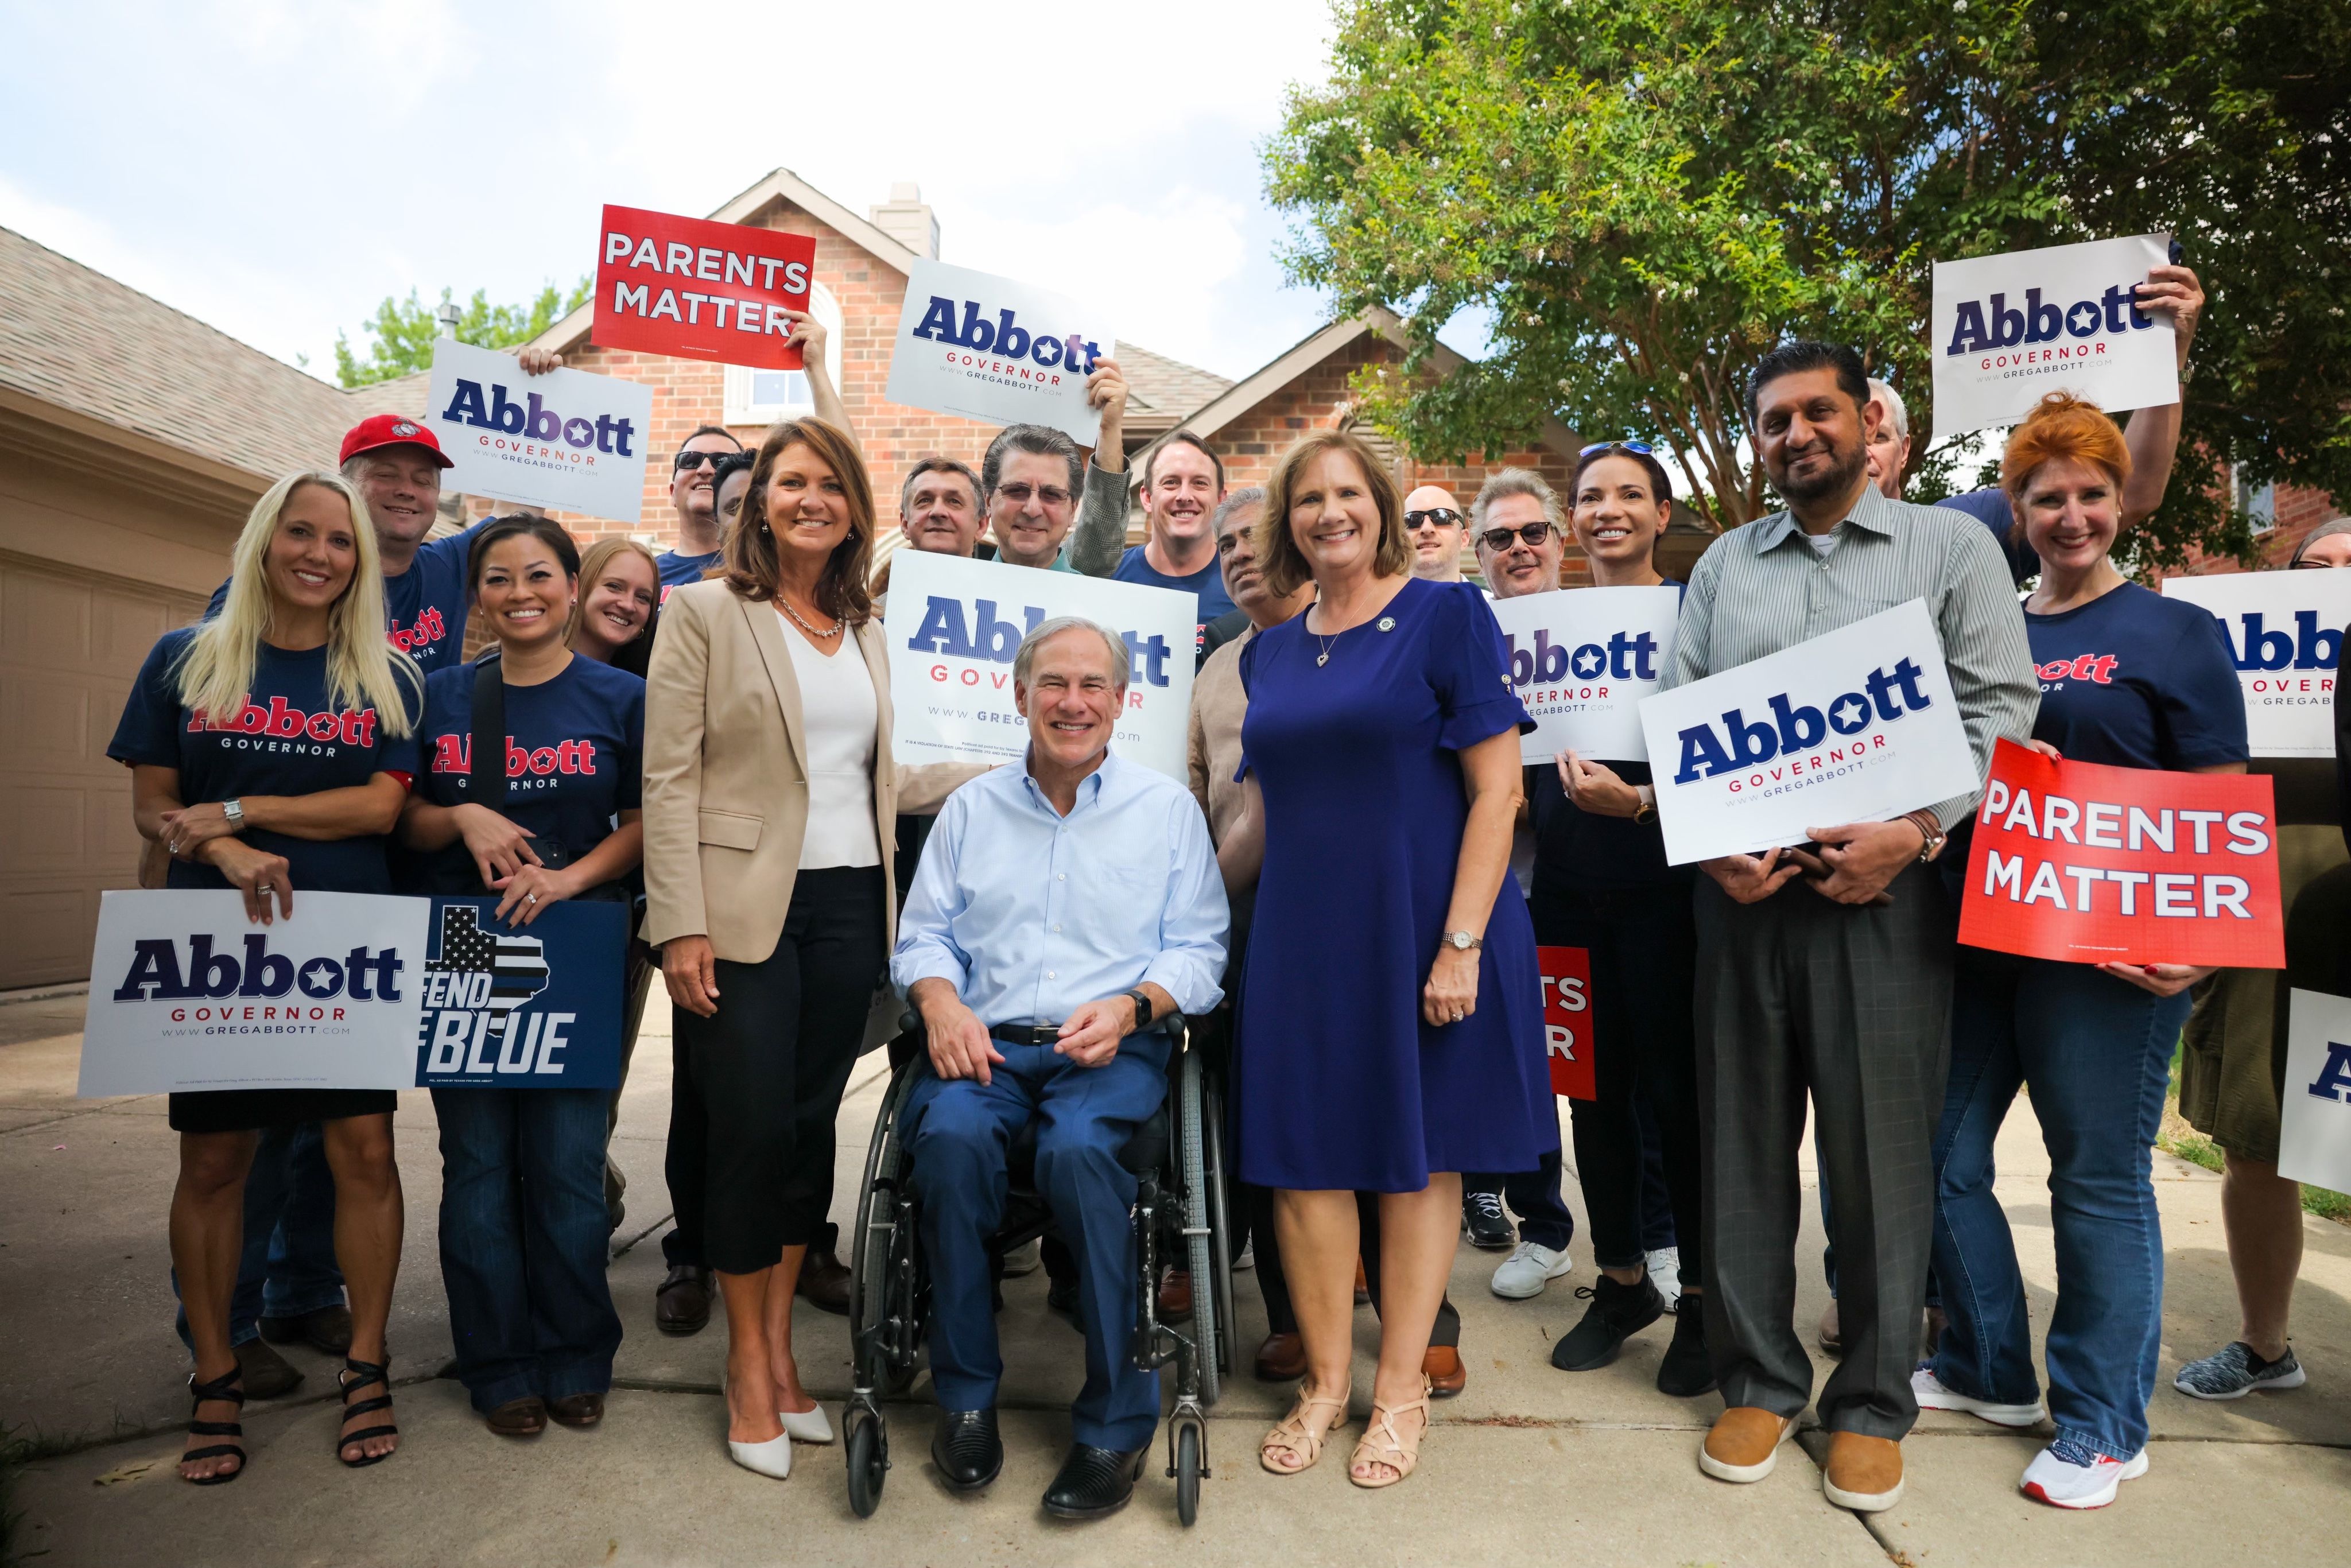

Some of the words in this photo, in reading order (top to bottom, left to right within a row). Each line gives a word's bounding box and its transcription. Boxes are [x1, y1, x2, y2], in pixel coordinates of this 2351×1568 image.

[604, 231, 808, 295] PARENTS
[614, 281, 792, 337] MATTER
[913, 296, 1102, 377] Abbott
[1947, 281, 2154, 358] Abbott
[946, 352, 1061, 386] GOVERNOR
[1981, 343, 2106, 370] GOVERNOR
[442, 378, 635, 458] Abbott
[479, 435, 595, 466] GOVERNOR
[385, 606, 446, 653] bott
[908, 595, 1171, 688] Abtt
[1526, 704, 1613, 716] EGABBOTT.COM
[1674, 656, 1933, 787] Abbott
[222, 738, 336, 758] GOVERNOR
[1729, 734, 1886, 793] GOVERNOR
[458, 778, 557, 790] GRNOR
[1983, 779, 2270, 855] PARENTS
[1984, 849, 2253, 918] MATTER
[113, 933, 405, 1003] Abbott
[171, 1007, 346, 1022] GOVERNOR
[426, 1011, 576, 1074] BLUE
